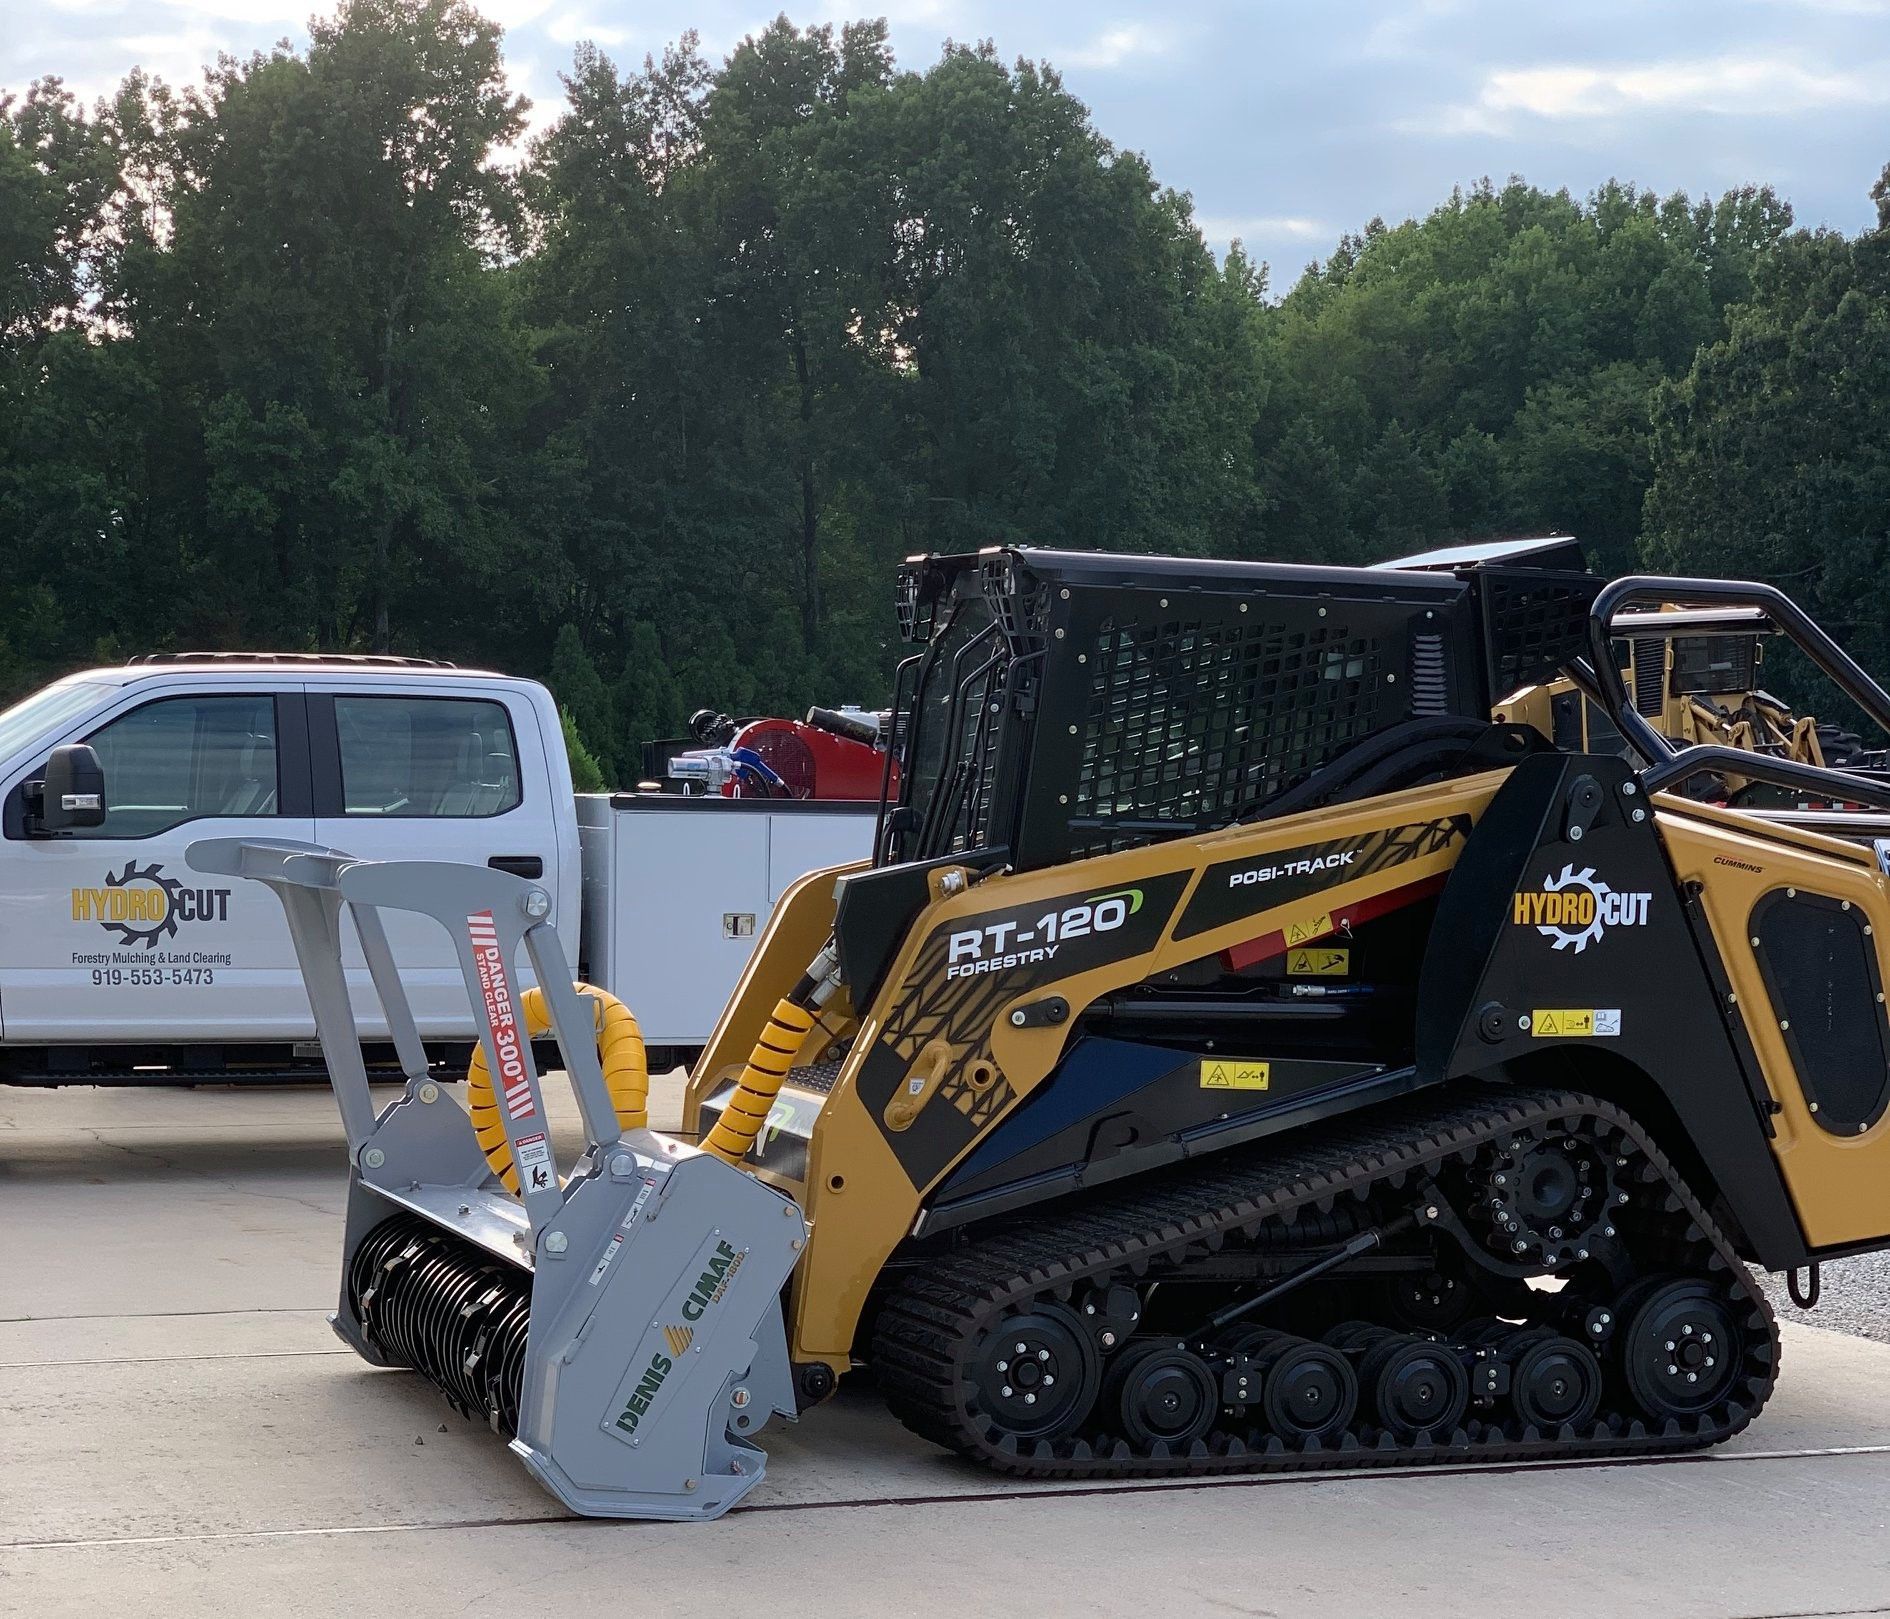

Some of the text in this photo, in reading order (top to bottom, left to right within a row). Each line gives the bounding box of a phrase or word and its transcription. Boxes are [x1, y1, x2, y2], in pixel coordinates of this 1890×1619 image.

[1229, 851, 1355, 888] POSI-TRACK
[1713, 856, 1764, 874] CUMMINS
[71, 888, 232, 921] HYDRO CUT
[1513, 892, 1653, 926] HYDRO CUT
[948, 899, 1126, 964] RT-120
[72, 952, 232, 966] Forestry Mulching & Land Clearing
[92, 968, 214, 986] 919-553-5473
[946, 945, 1060, 981] FORESTRY
[475, 952, 499, 1028] STAND CLEAR
[484, 947, 525, 1082] DANGER 300'
[615, 1240, 736, 1435] DENIS CIMAF
